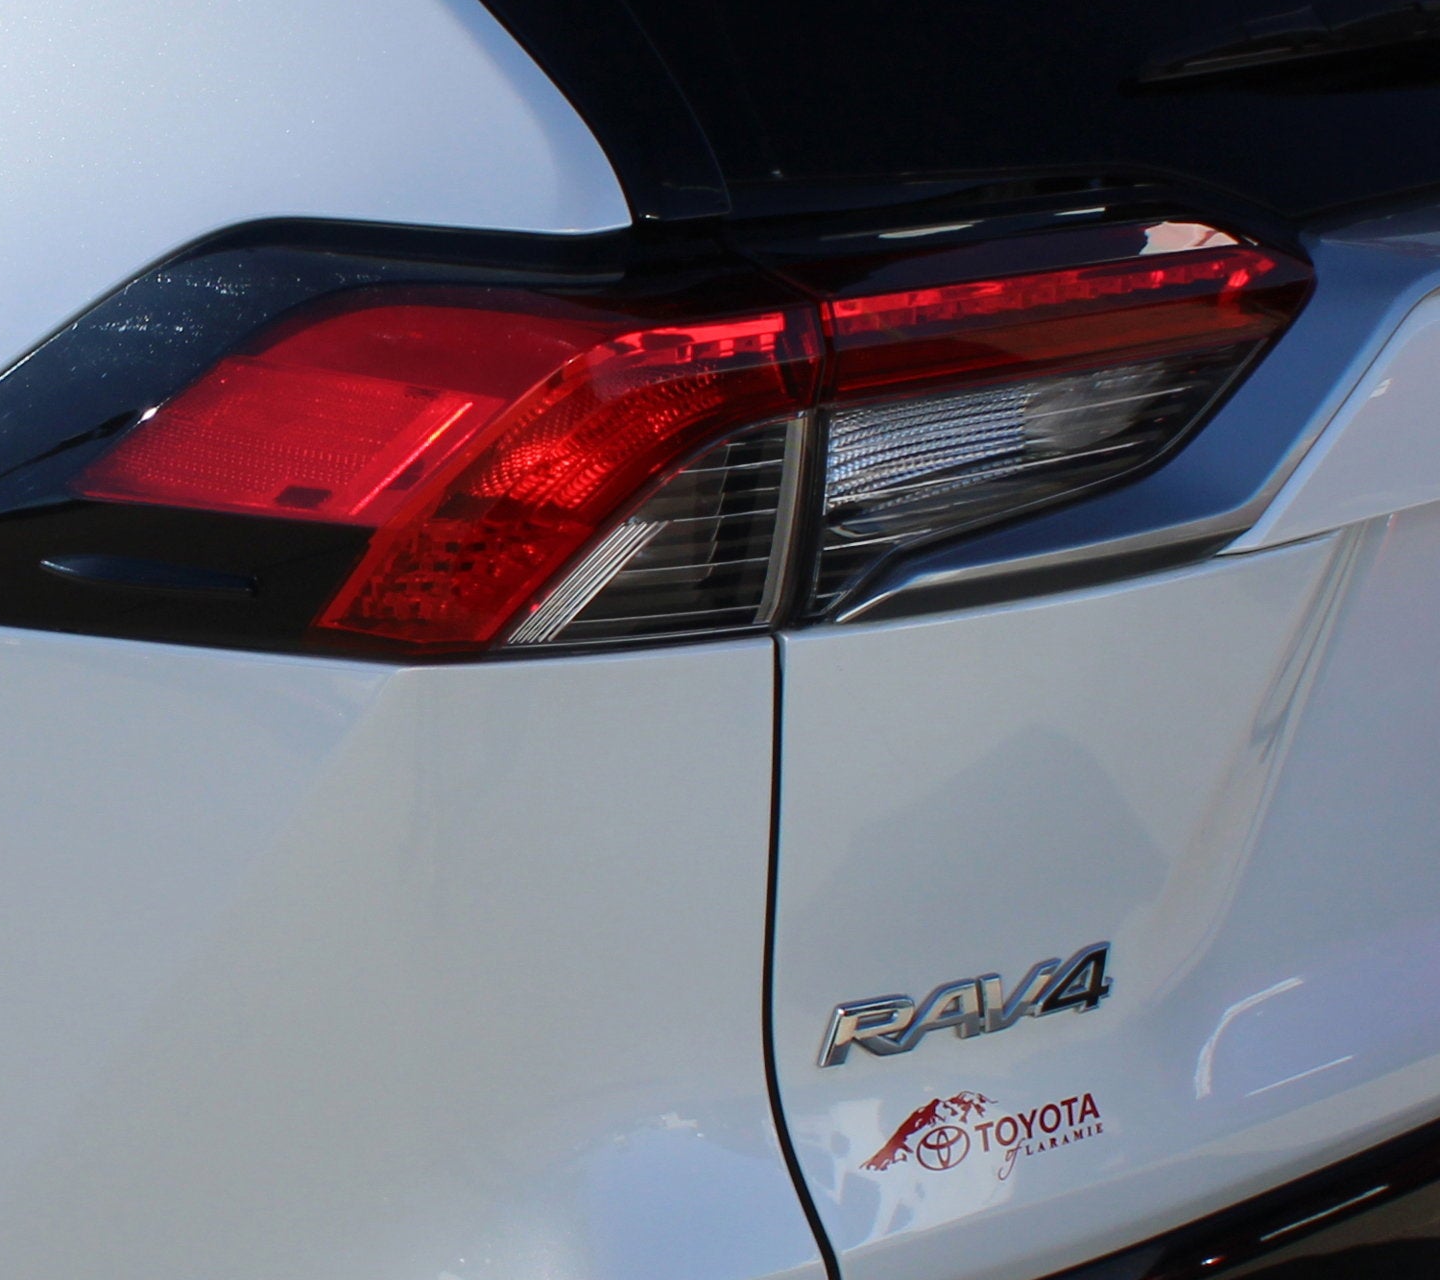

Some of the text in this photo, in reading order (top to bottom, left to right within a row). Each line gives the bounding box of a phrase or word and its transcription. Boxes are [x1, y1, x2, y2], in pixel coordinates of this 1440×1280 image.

[817, 939, 1113, 1068] RAV4
[974, 1092, 1101, 1153] TOYOTA
[997, 1122, 1105, 1181] of LARAMIE
